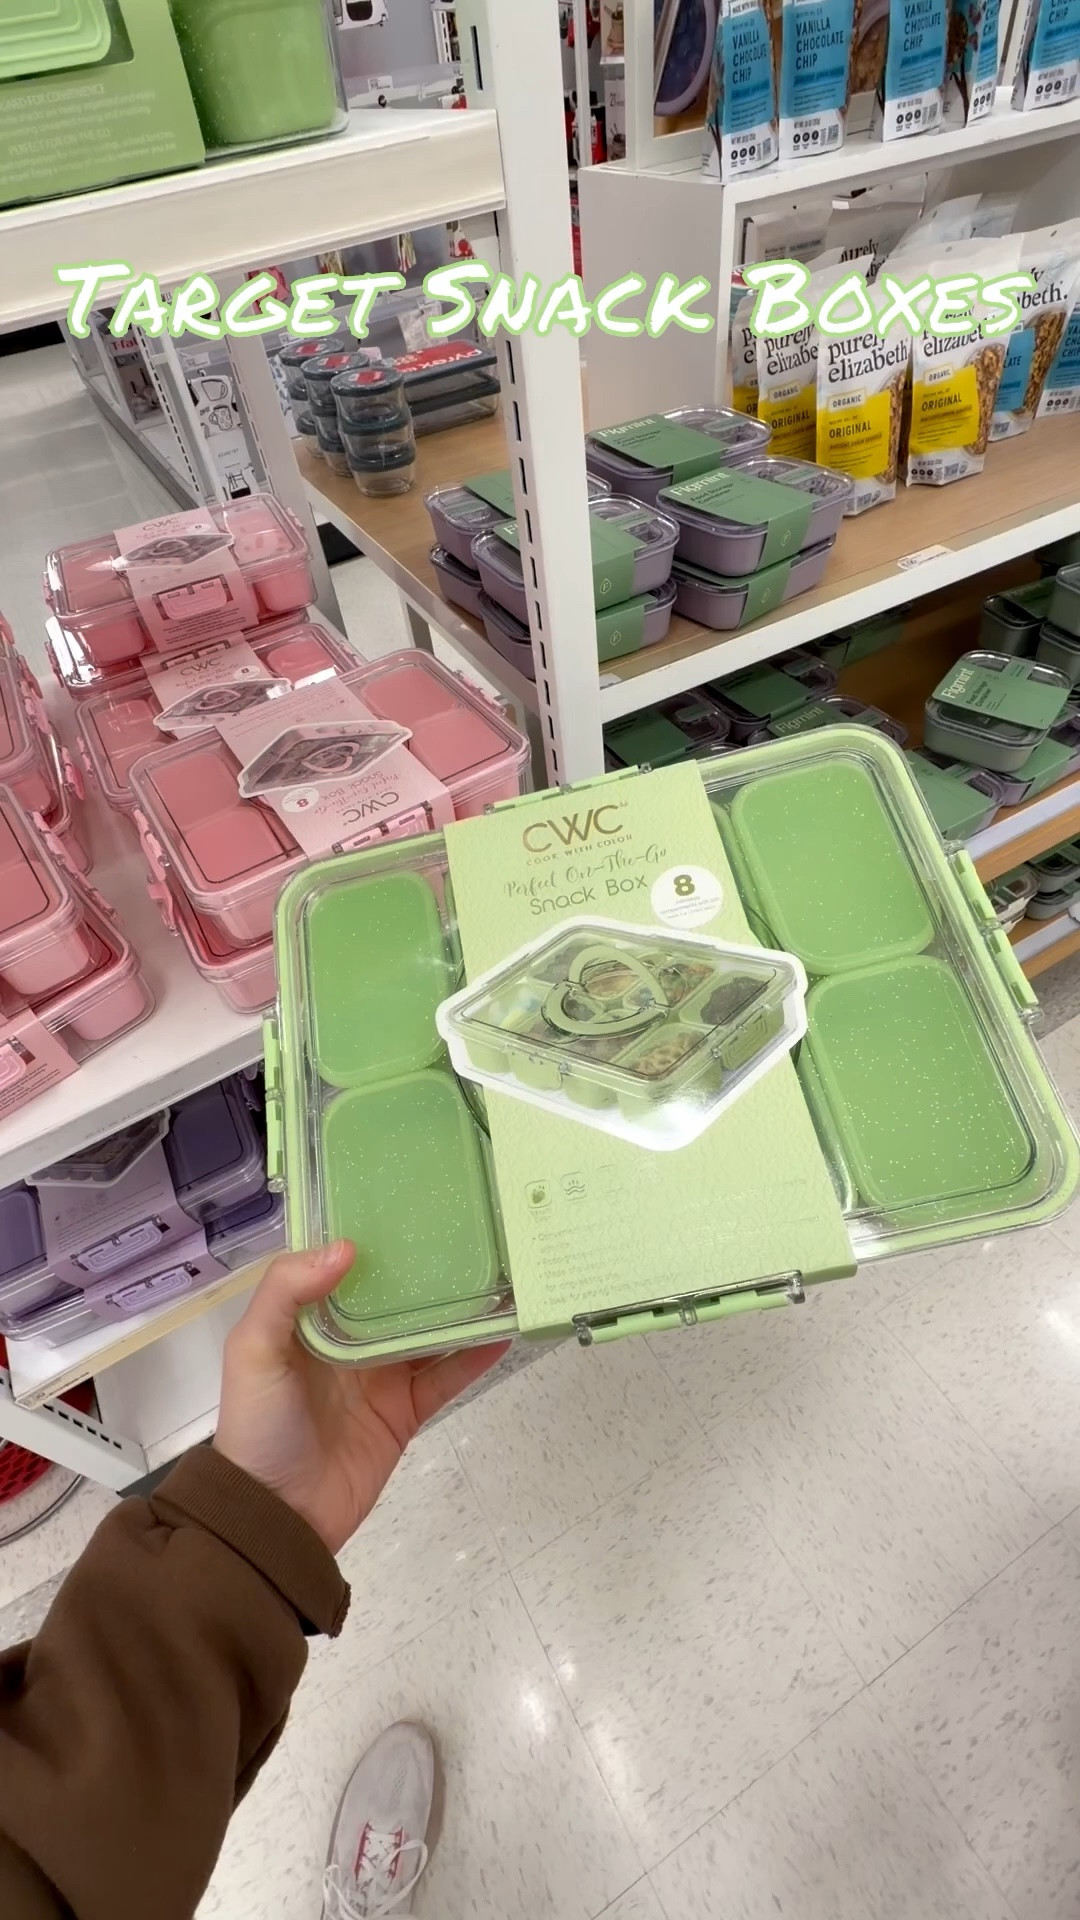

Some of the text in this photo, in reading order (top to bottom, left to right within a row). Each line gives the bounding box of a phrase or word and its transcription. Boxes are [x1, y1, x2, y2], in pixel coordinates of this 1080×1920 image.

[904, 13, 941, 35] CHOCOLATE
[1049, 7, 1068, 24] CHIP
[795, 17, 831, 37] VANILLA
[732, 29, 760, 49] VANILLA
[796, 31, 844, 53] CHOCOLATE
[903, 35, 924, 51] CHIP
[732, 44, 768, 67] CHOCOLATE
[795, 53, 818, 71] CHIP
[732, 67, 752, 84] CHIP
[828, 332, 885, 366] purely
[928, 369, 950, 382] ORGANIC
[773, 385, 799, 398] ORGANIC
[832, 395, 862, 408] ORGANIC
[921, 393, 962, 412] ORIGINAL
[597, 418, 657, 438] Figmint
[771, 409, 810, 429] ORIGINAL
[829, 420, 872, 439] ORIGINAL
[670, 471, 731, 497] Figmint
[180, 657, 223, 676] CWC
[942, 668, 975, 699] Figmint
[776, 706, 825, 733] Figmint
[343, 792, 399, 823] CWC
[523, 804, 624, 853] CWC
[526, 853, 559, 866] COOK
[565, 845, 592, 857] WITH
[505, 869, 557, 897] Perfect
[673, 874, 695, 896] 8
[530, 875, 648, 915] Snack Box
